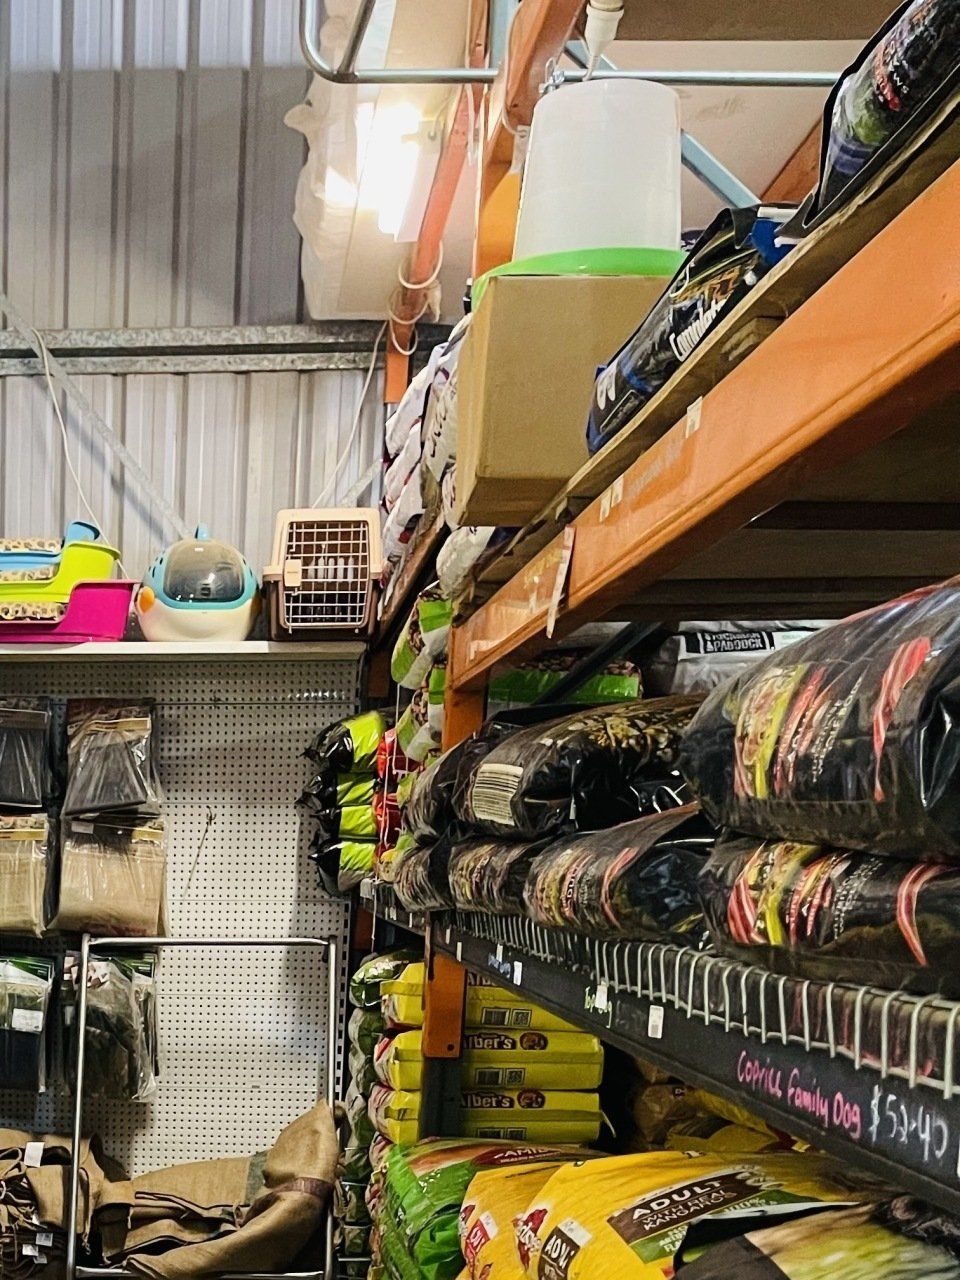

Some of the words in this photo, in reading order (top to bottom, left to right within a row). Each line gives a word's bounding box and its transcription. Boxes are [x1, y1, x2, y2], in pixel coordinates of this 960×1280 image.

[788, 1067, 829, 1128] Family
[833, 1091, 862, 1140] Dog
[632, 1180, 722, 1220] ADULT
[642, 1205, 686, 1225] WITH
